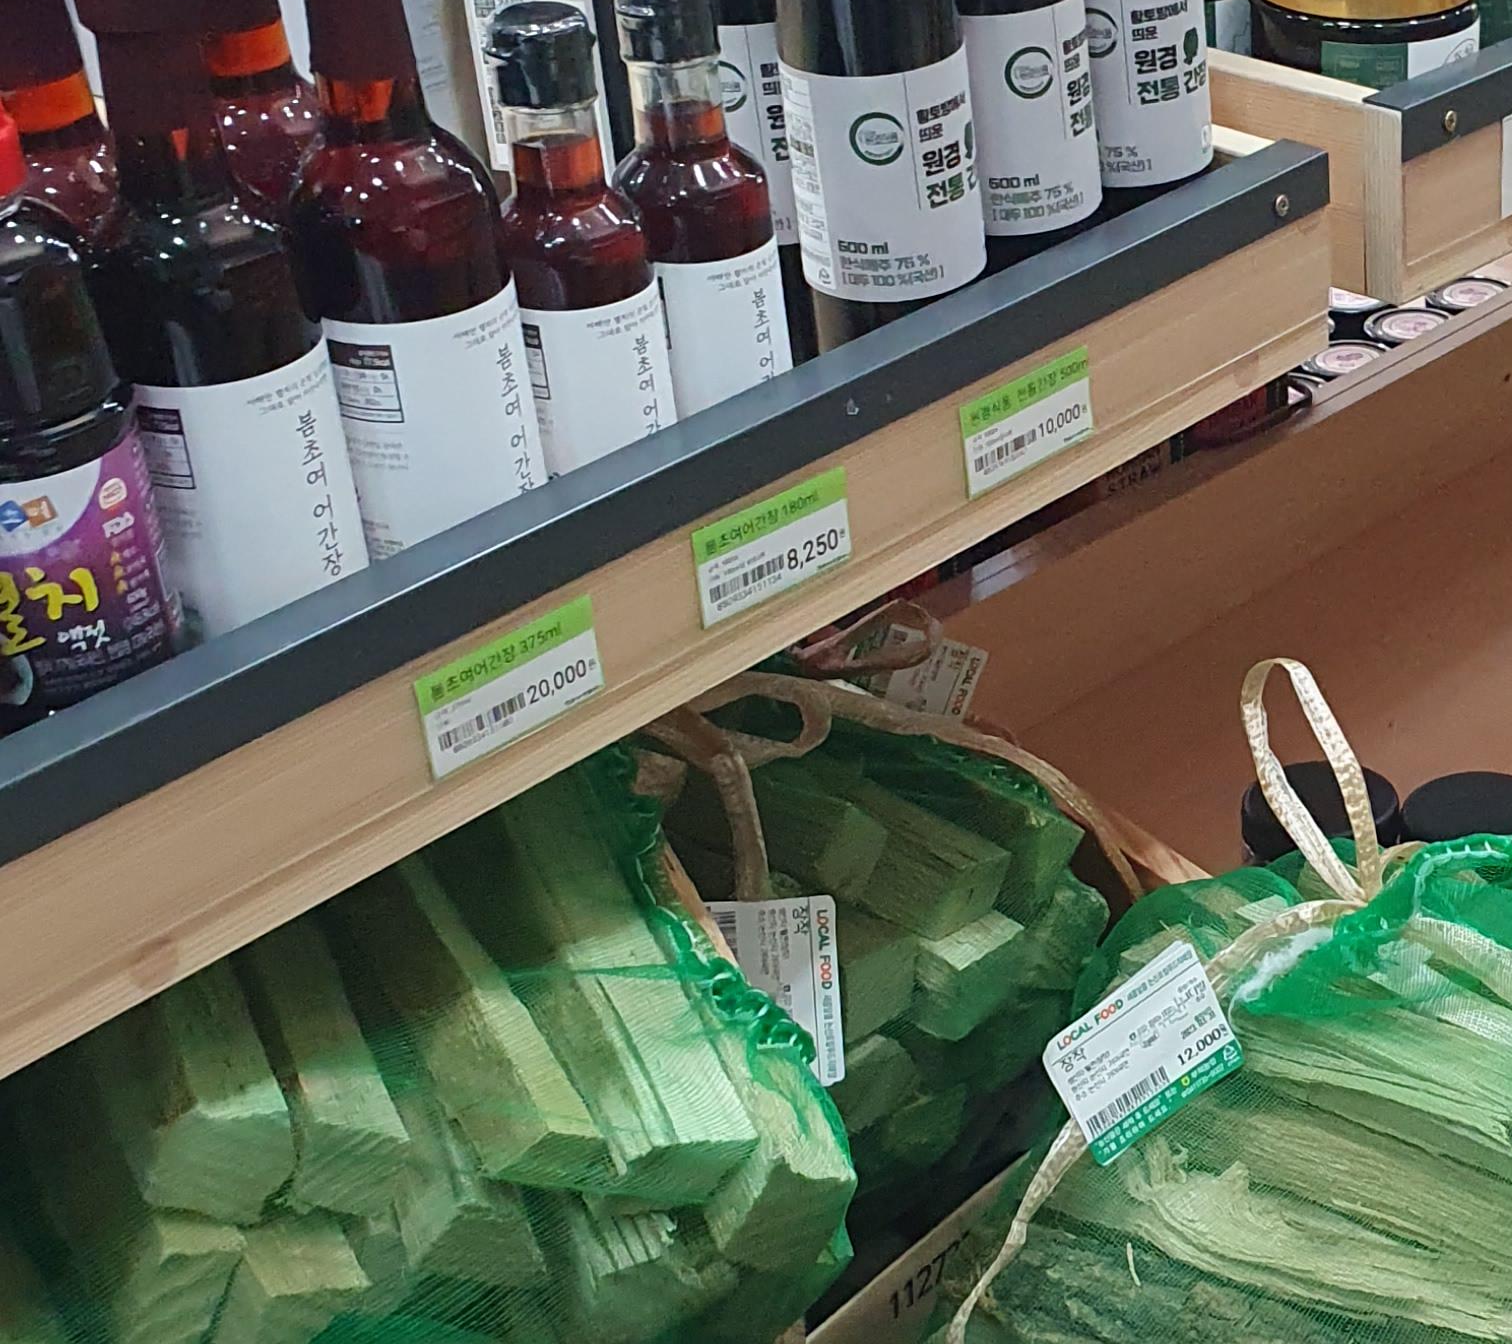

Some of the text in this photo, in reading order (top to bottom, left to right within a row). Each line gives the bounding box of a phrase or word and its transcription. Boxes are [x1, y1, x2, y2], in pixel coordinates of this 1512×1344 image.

[1130, 0, 1188, 25] 황토방에서
[1132, 26, 1158, 42] 띄운
[1134, 44, 1177, 75] 원경
[1137, 59, 1208, 106] 전통 간장
[916, 92, 967, 124] 황토방에서
[918, 123, 944, 143] 띄운
[922, 140, 961, 177] 원경
[927, 172, 965, 209] 전통
[1023, 174, 1040, 187] ml
[871, 240, 889, 255] ml
[1106, 460, 1162, 495] STRAW
[781, 490, 820, 516] 180ml
[313, 493, 344, 577] 어간장
[57, 619, 110, 651] 액젓
[518, 621, 562, 653] 375ml
[791, 906, 809, 935] 장작
[816, 909, 831, 952] LOCAL
[819, 955, 833, 991] FOOD
[1056, 998, 1125, 1052] LOCAL FOOD
[1059, 1047, 1088, 1073] 장작
